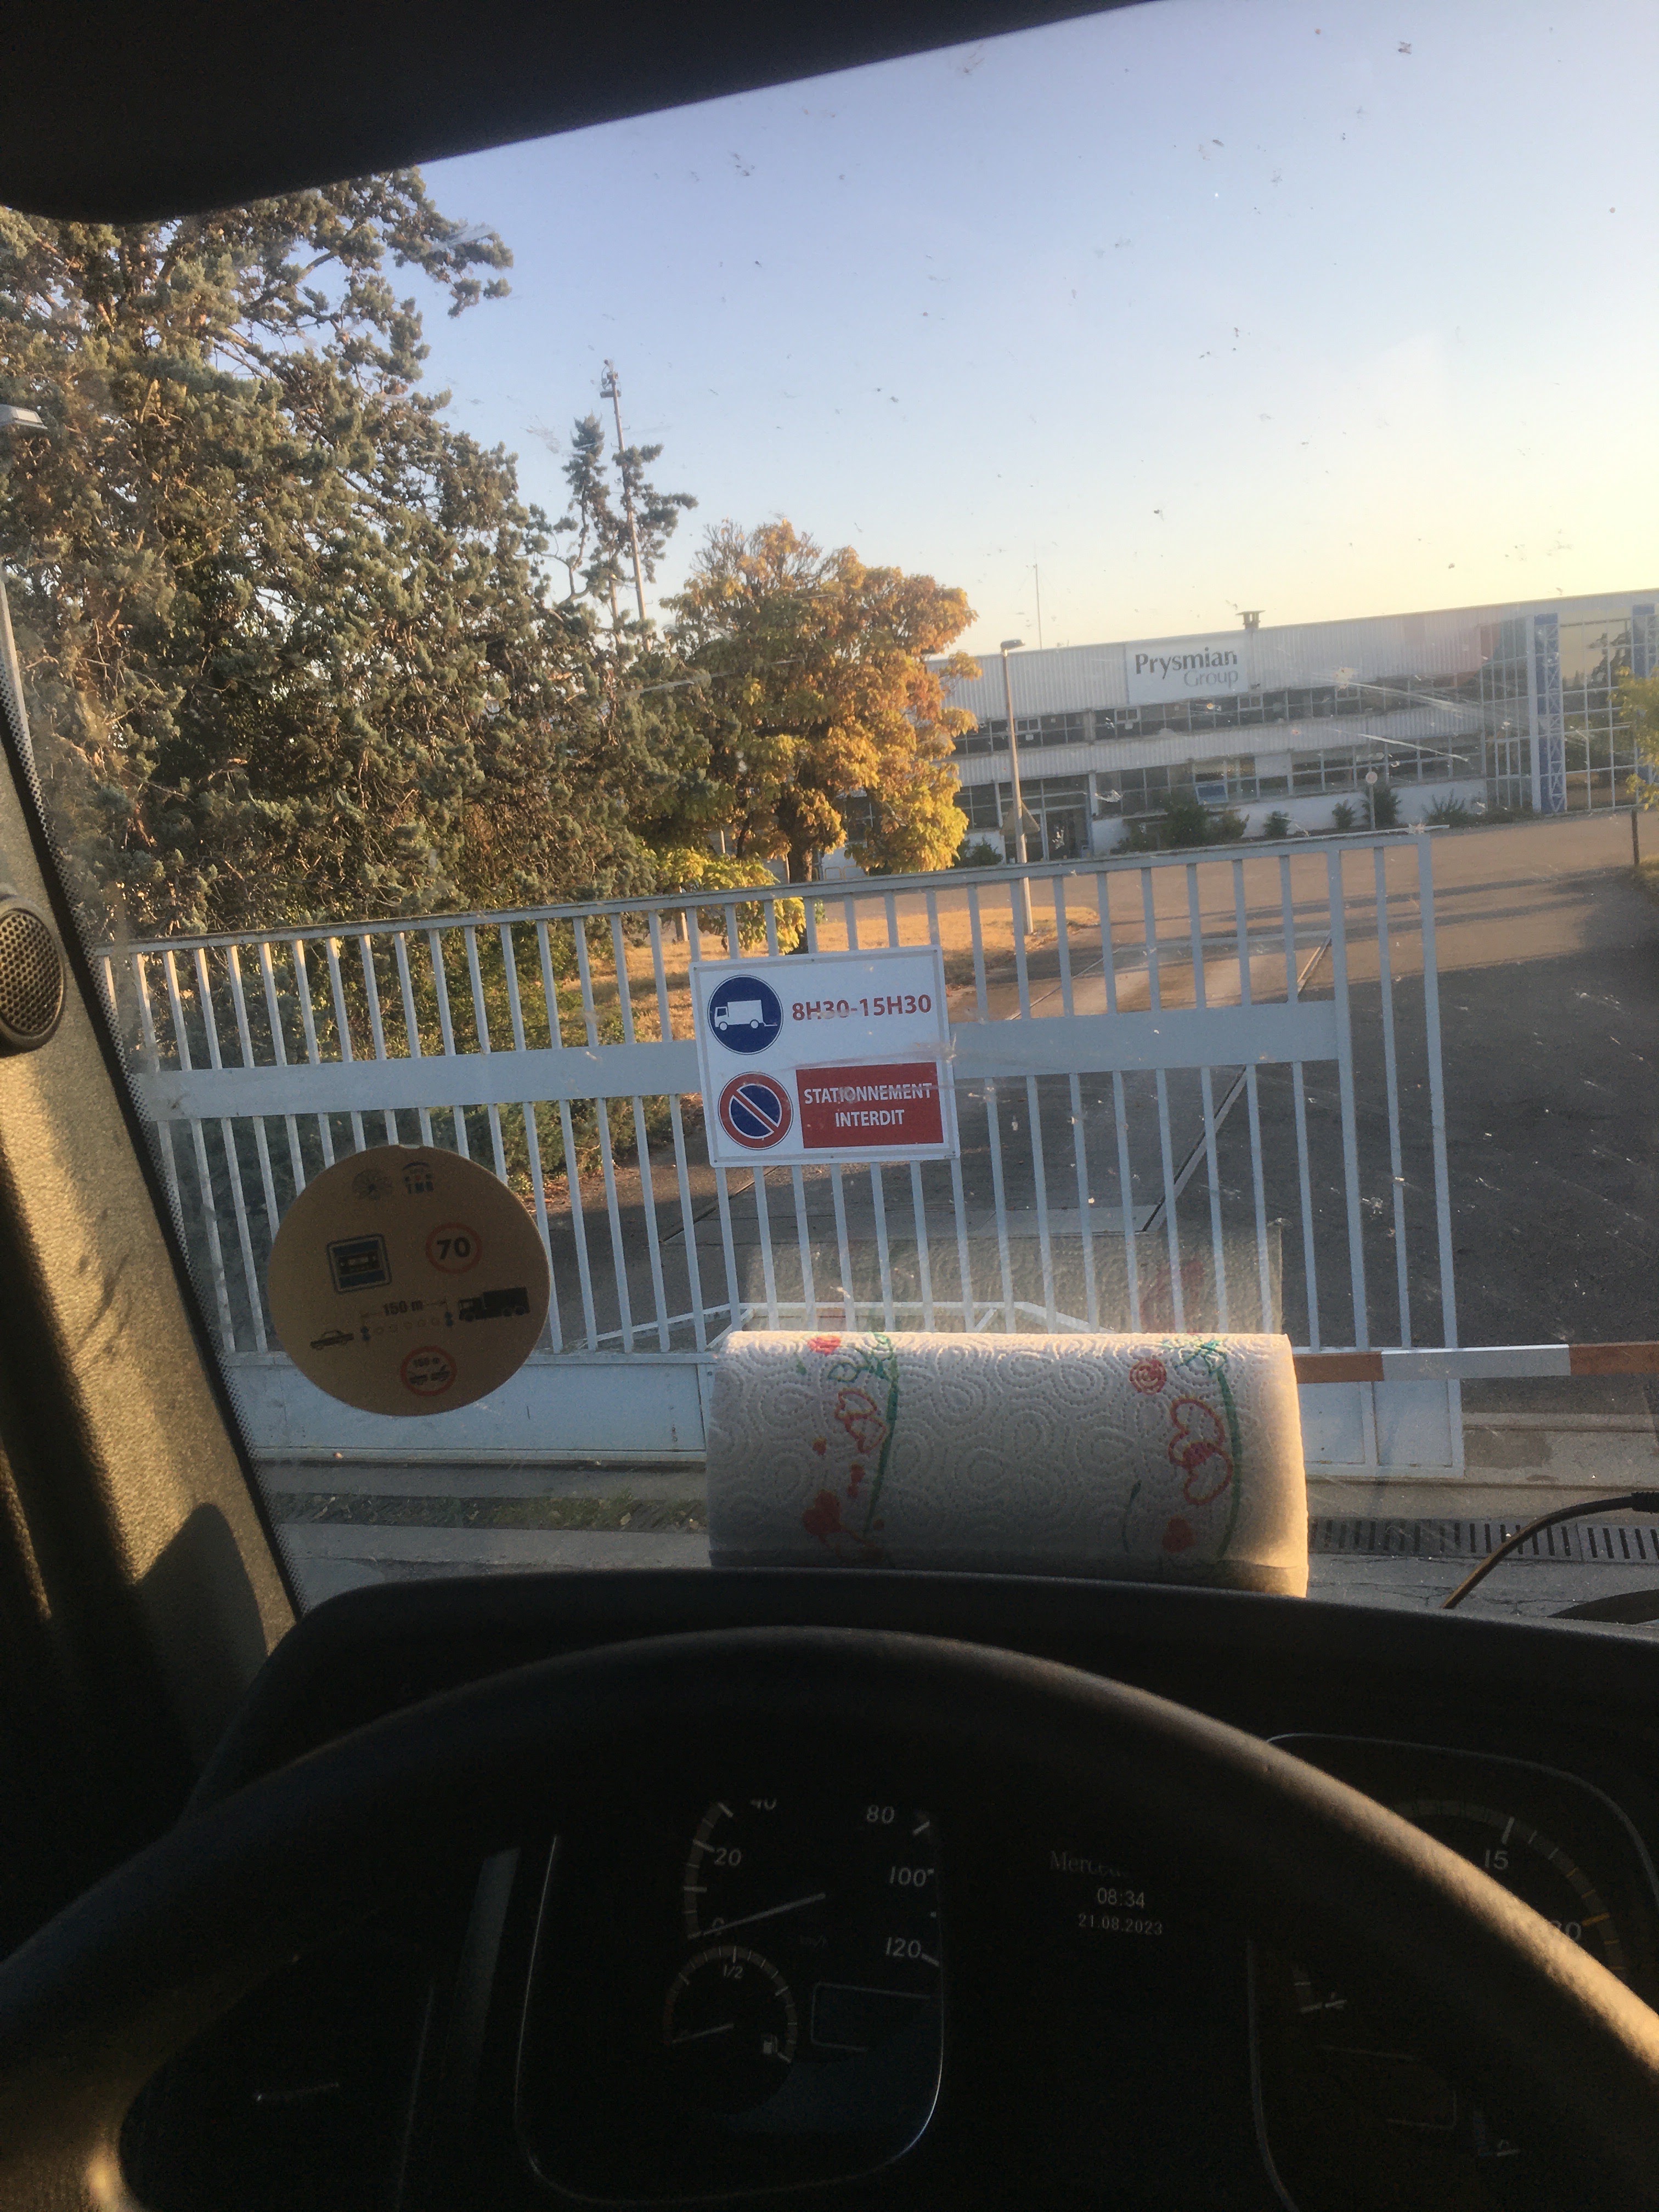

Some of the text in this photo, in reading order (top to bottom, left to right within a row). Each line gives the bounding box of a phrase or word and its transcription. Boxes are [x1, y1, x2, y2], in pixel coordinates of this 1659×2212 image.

[1135, 646, 1238, 680] Prysmian
[1184, 670, 1239, 689] Group
[792, 994, 932, 1021] 8H30-15H30
[804, 1082, 932, 1104] STATIONNEMENT
[834, 1109, 905, 1127] INTERDIT
[437, 1236, 471, 1260] 70
[866, 1804, 895, 1824] 80
[713, 1847, 743, 1867] 20
[1485, 1849, 1509, 1870] 15
[889, 1866, 927, 1887] 100
[1097, 1886, 1146, 1909] 08:34
[1077, 1911, 1164, 1936] 21.08.2023
[885, 1936, 922, 1959] 120
[723, 1964, 744, 1980] 1/2
